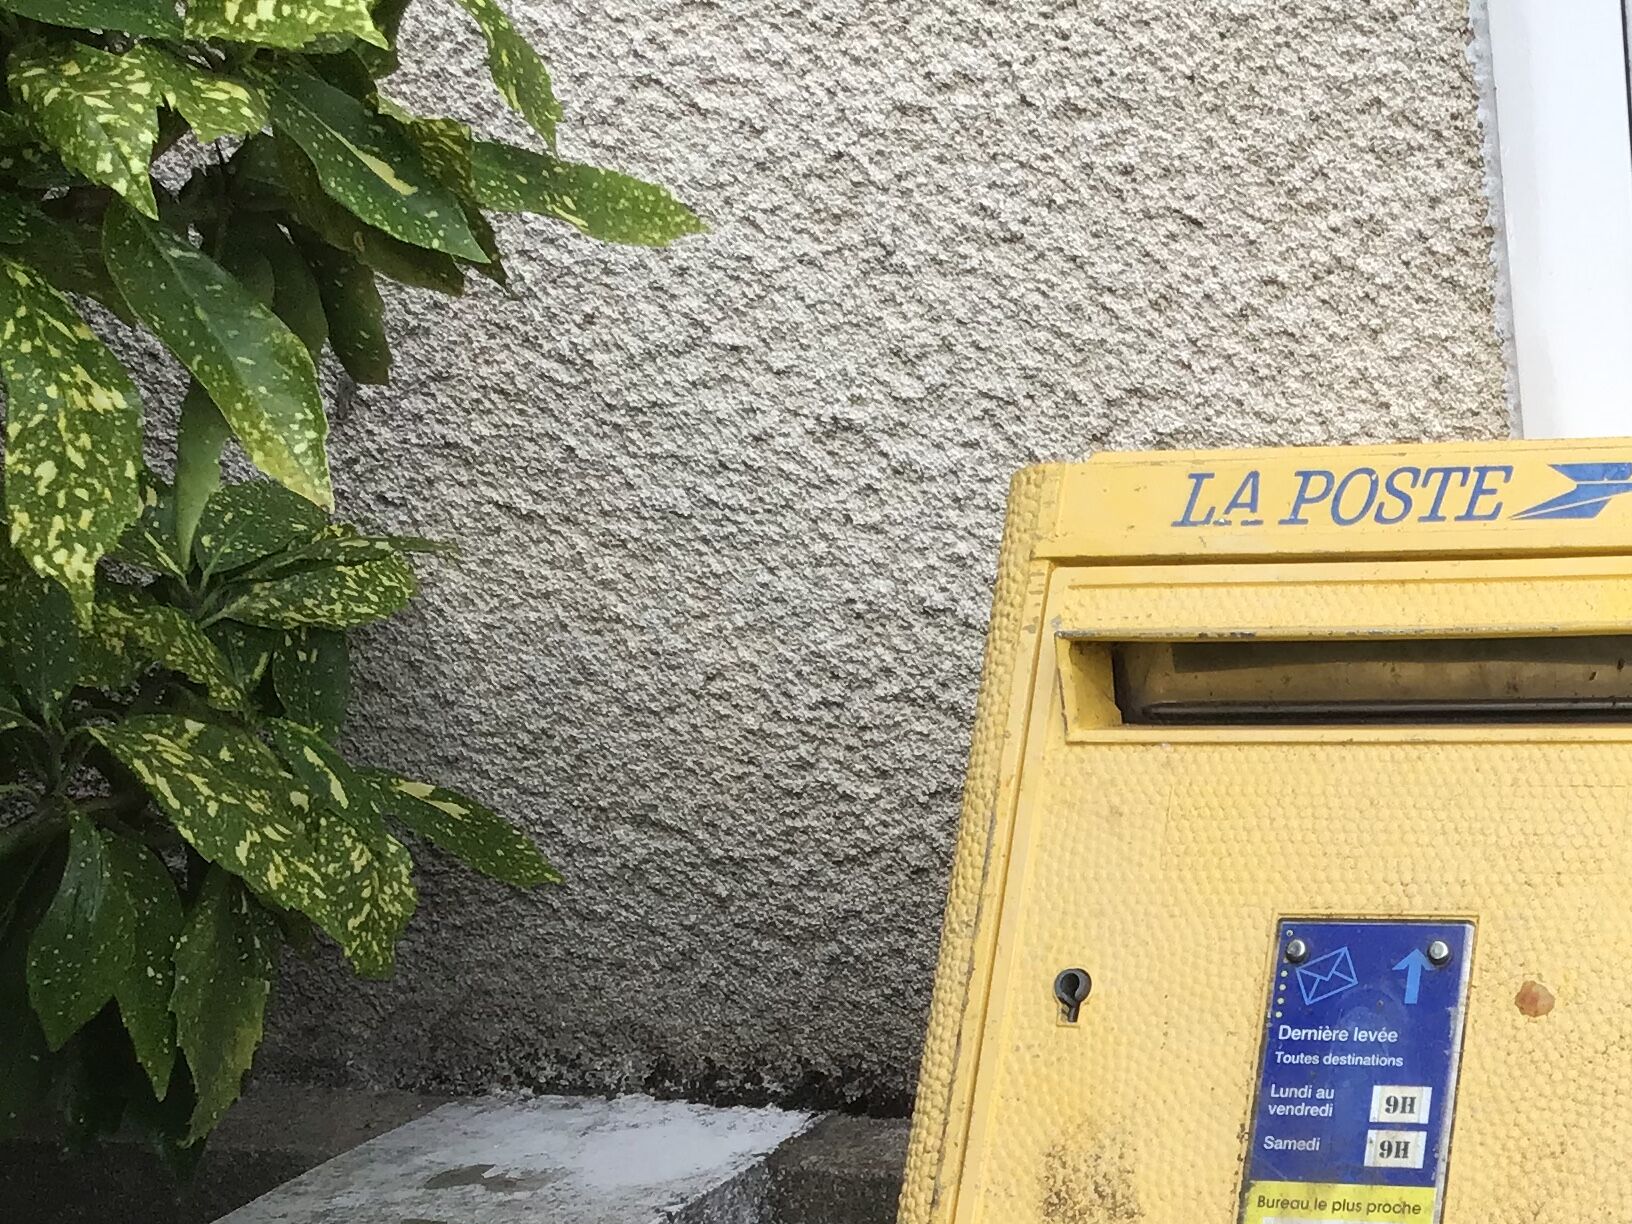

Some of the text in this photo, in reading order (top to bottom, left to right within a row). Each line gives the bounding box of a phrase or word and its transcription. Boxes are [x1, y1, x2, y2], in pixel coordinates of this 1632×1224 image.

[1171, 465, 1513, 528] LA POSTE
[1277, 1024, 1398, 1043] Dernière levée
[1275, 1051, 1404, 1068] Toutes destinations
[1270, 1083, 1335, 1100] Lundi au
[1268, 1095, 1417, 1117] vendredi 9H
[1263, 1135, 1411, 1160] Samedi 9H
[1257, 1195, 1422, 1215] Bureau le plus proche
